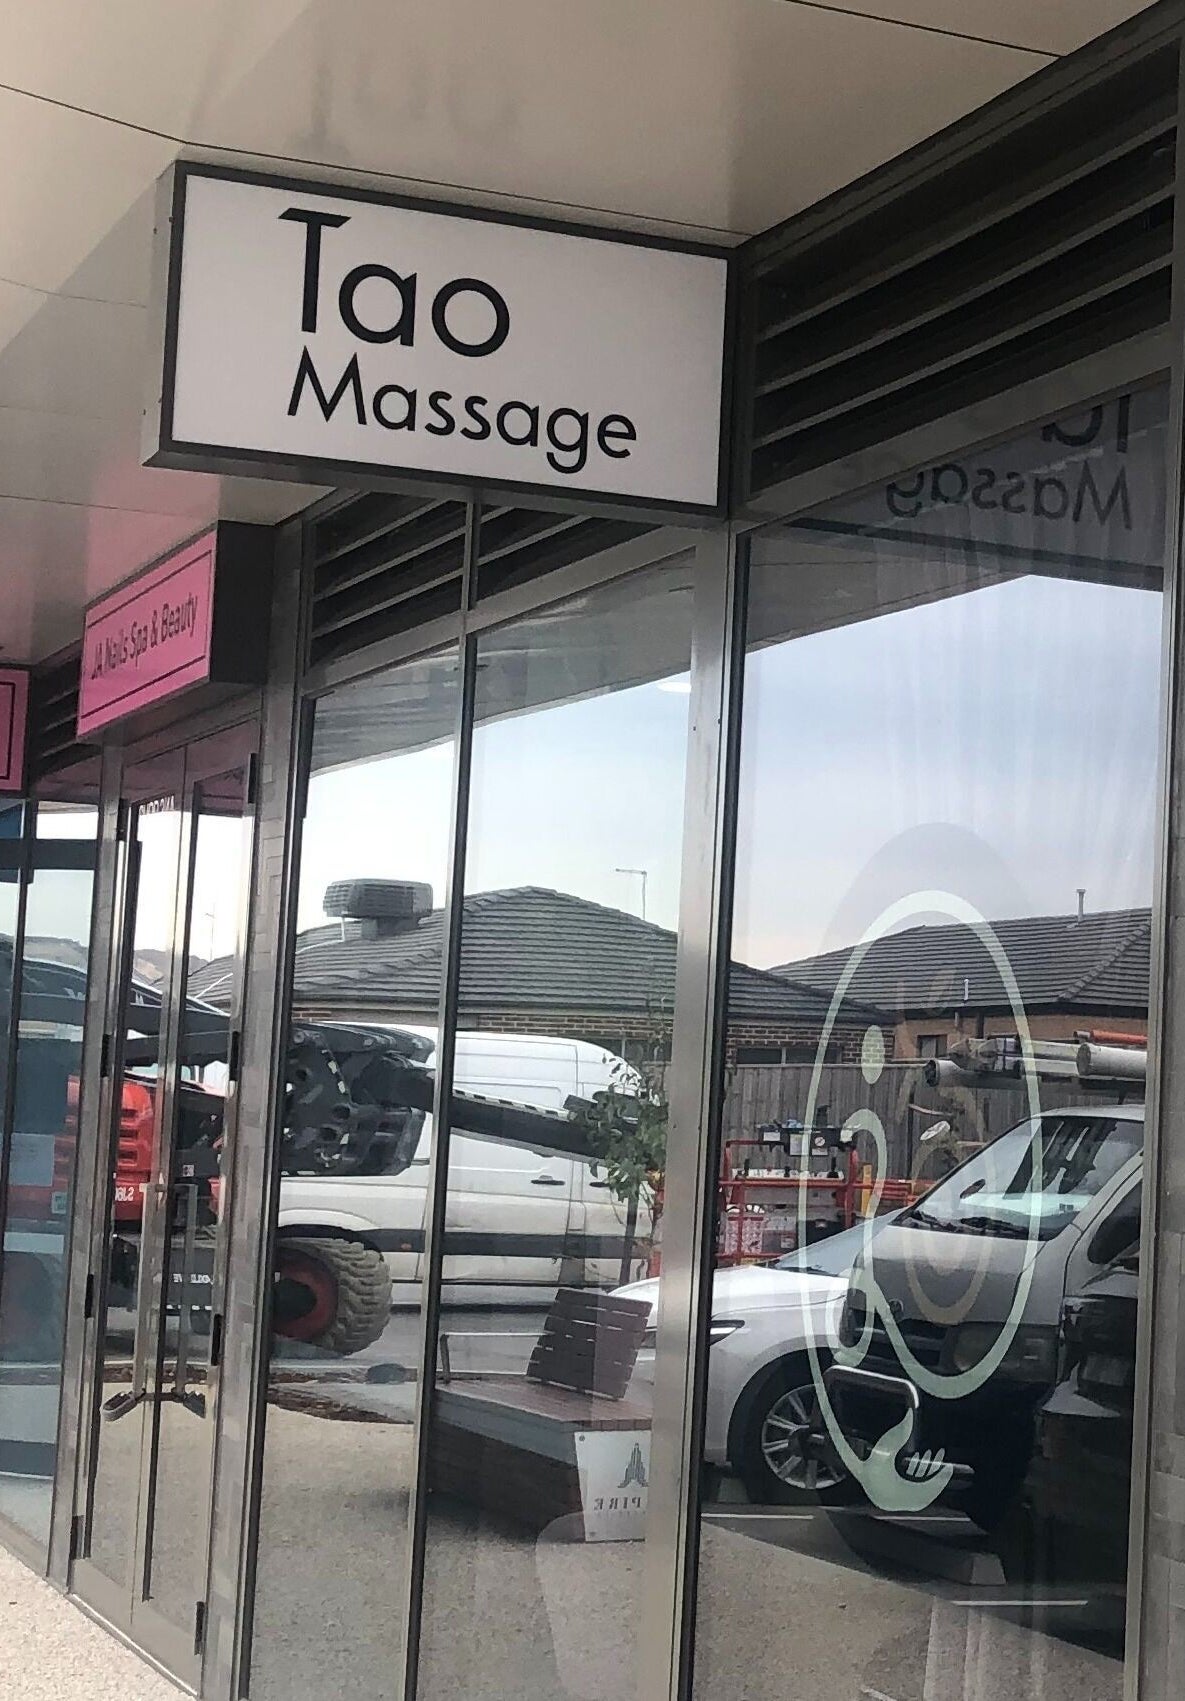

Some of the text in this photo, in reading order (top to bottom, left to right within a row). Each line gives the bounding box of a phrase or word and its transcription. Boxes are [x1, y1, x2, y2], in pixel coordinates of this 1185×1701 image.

[278, 207, 510, 357] Tao
[287, 345, 636, 474] Massage
[130, 620, 148, 668] Spa
[150, 609, 158, 649] &
[161, 592, 198, 642] Beauty
